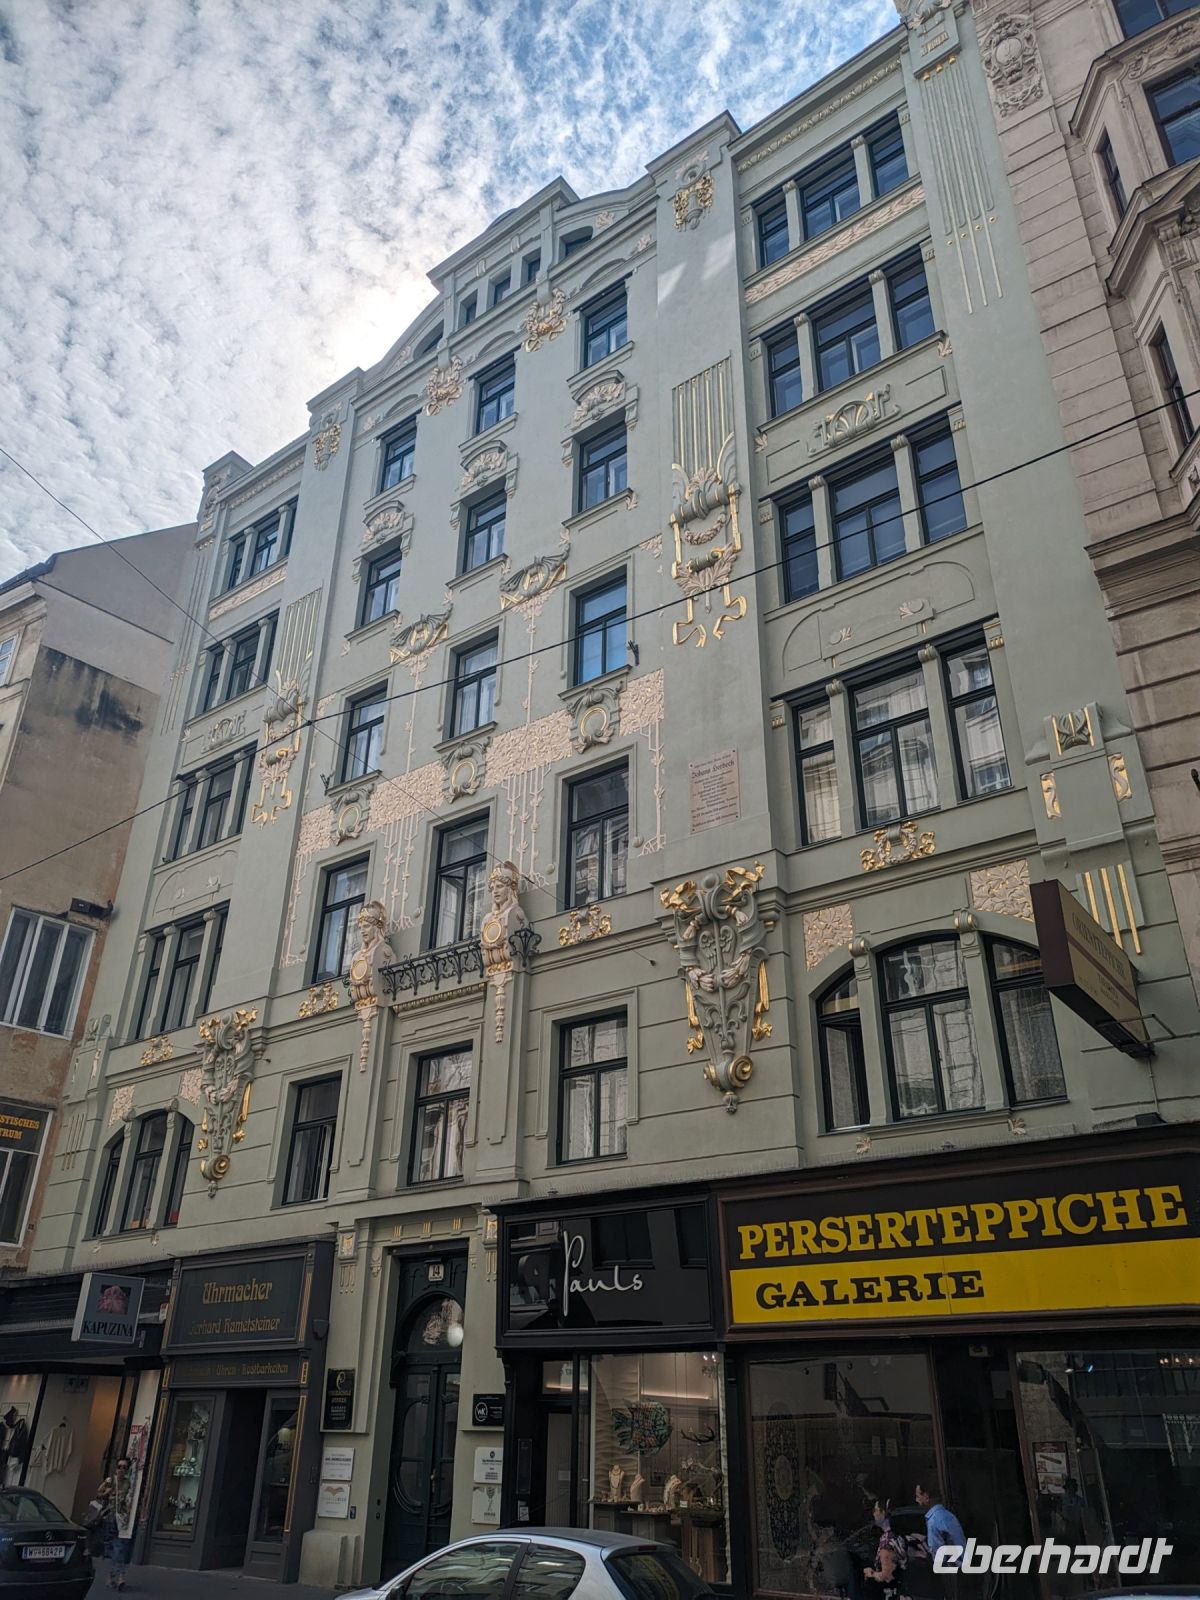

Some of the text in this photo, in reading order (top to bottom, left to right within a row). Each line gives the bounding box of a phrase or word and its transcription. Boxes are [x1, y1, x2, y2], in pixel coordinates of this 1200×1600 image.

[738, 1185, 1189, 1260] PERSERTEPPICHE
[203, 1278, 273, 1304] Uhrmacher
[562, 1230, 644, 1317] Pauls
[756, 1270, 985, 1310] GALERIE
